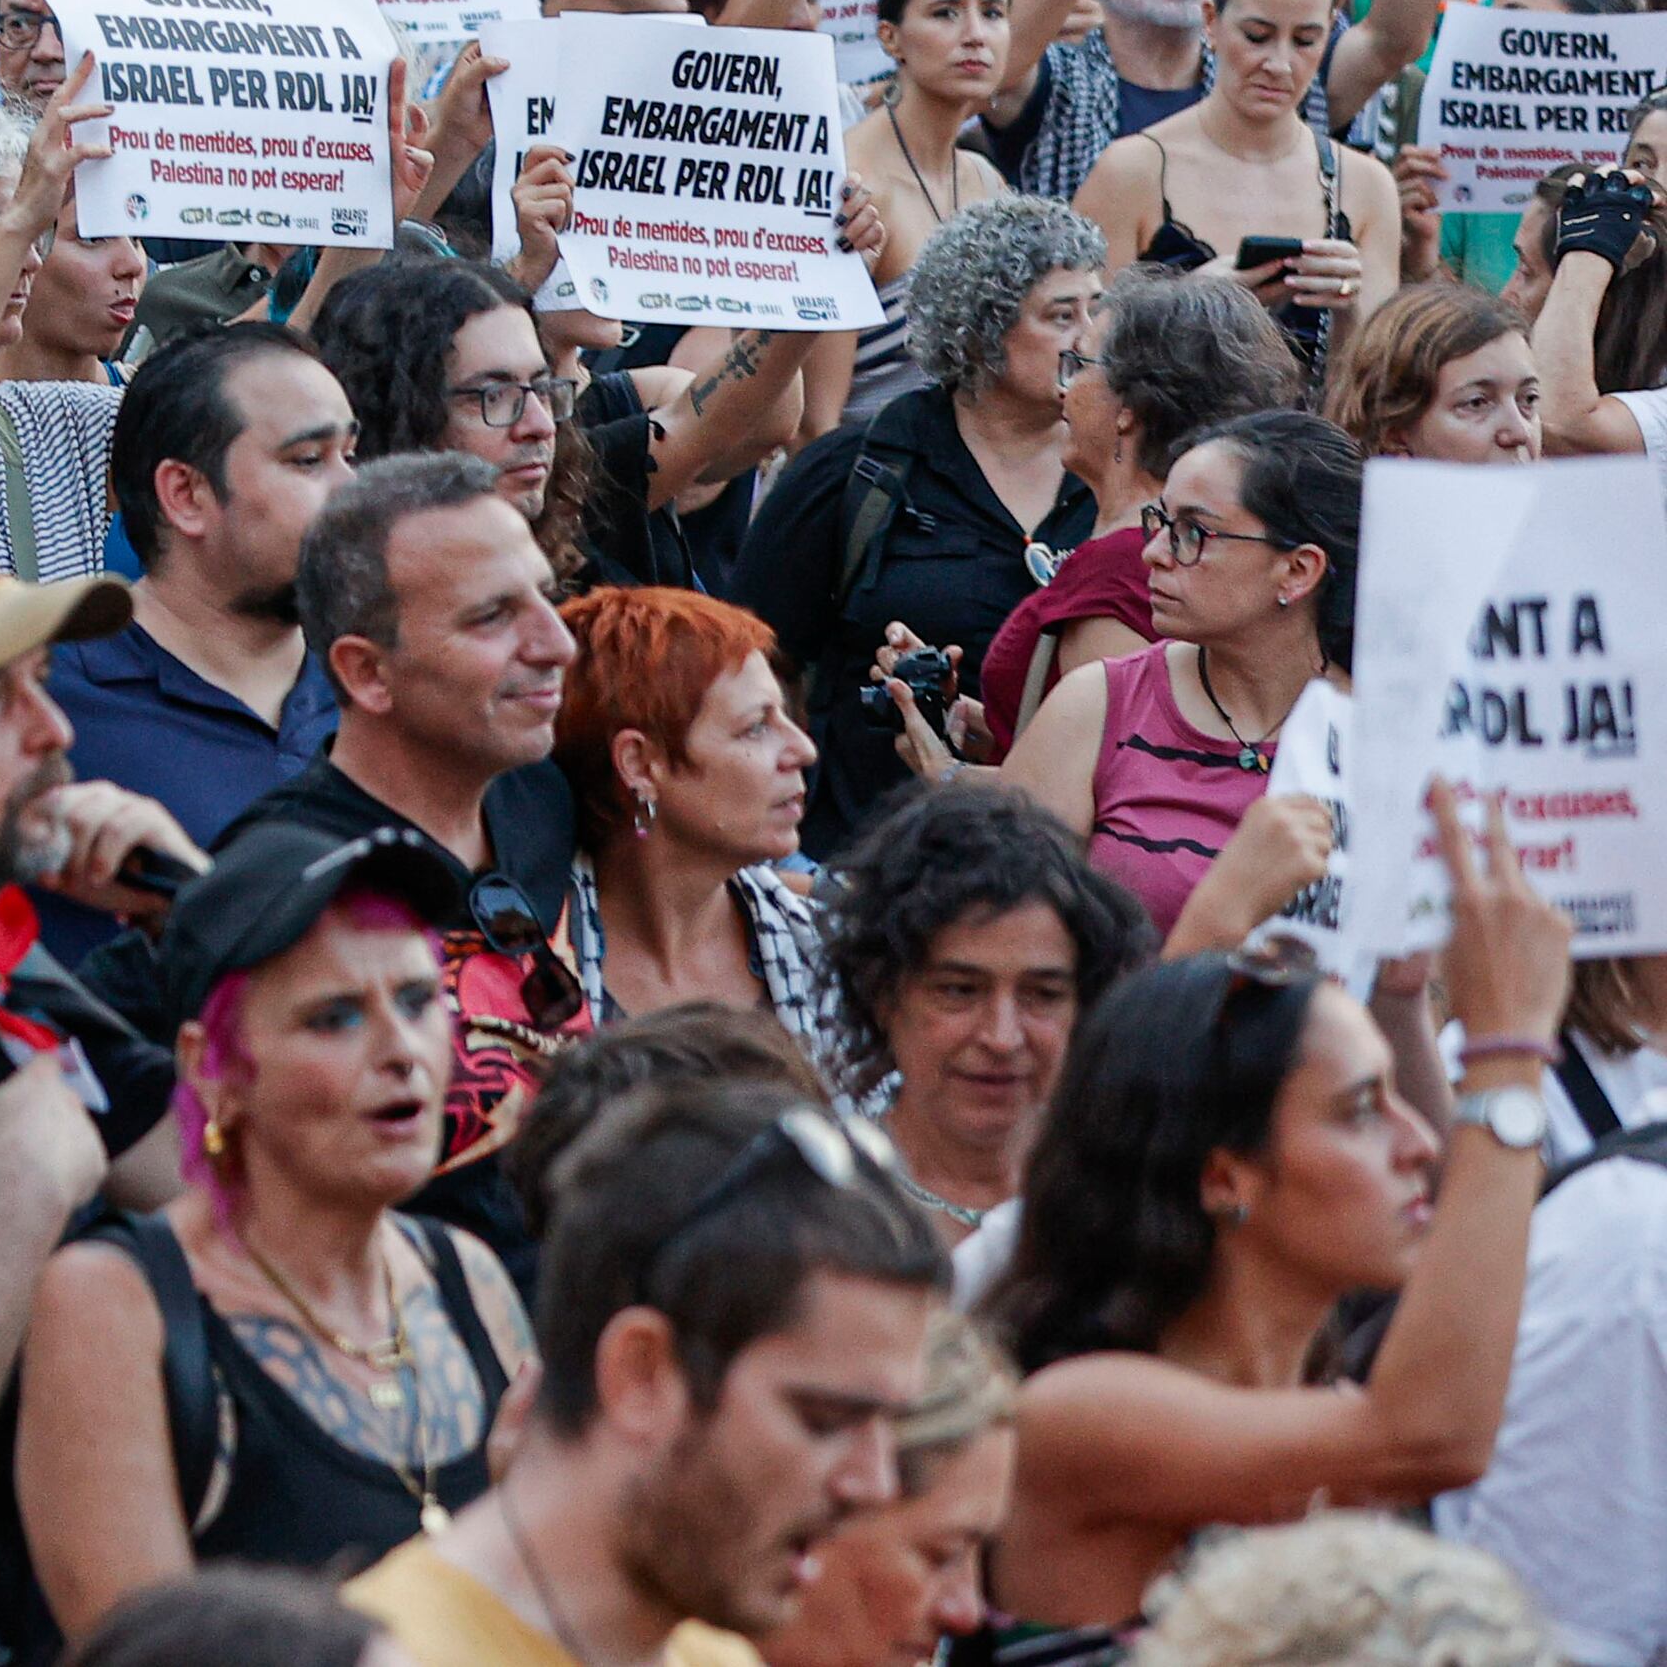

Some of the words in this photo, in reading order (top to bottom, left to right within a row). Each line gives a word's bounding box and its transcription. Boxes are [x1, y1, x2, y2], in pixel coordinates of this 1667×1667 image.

[94, 14, 328, 58] EMBARGAMENT
[336, 27, 361, 60] A
[1500, 28, 1617, 61] GOVERN,
[101, 63, 203, 105] ISRAEL
[211, 67, 267, 109] PER
[276, 71, 333, 112] RDL
[341, 75, 377, 115] JA!
[672, 49, 782, 101] GOVERN,
[1451, 61, 1655, 96] EMBARGAMENT
[601, 96, 809, 154] EMBARGAMENT
[811, 115, 828, 155] A
[1440, 99, 1527, 131] ISRAEL
[1535, 106, 1588, 133] PER
[576, 149, 666, 195] ISRAEL
[675, 158, 729, 200] PER
[734, 163, 785, 206] RDL
[793, 170, 833, 210] JA!
[573, 211, 609, 235] Prou
[614, 215, 632, 238] de
[637, 221, 709, 247] mentides,
[715, 229, 748, 250] prou
[754, 228, 829, 257] d'excuses,
[609, 246, 678, 273] Palestina
[683, 256, 701, 274] no
[707, 257, 732, 279] pot
[735, 262, 799, 283] esperar!
[1570, 590, 1605, 657] A
[1562, 680, 1636, 745] JA!
